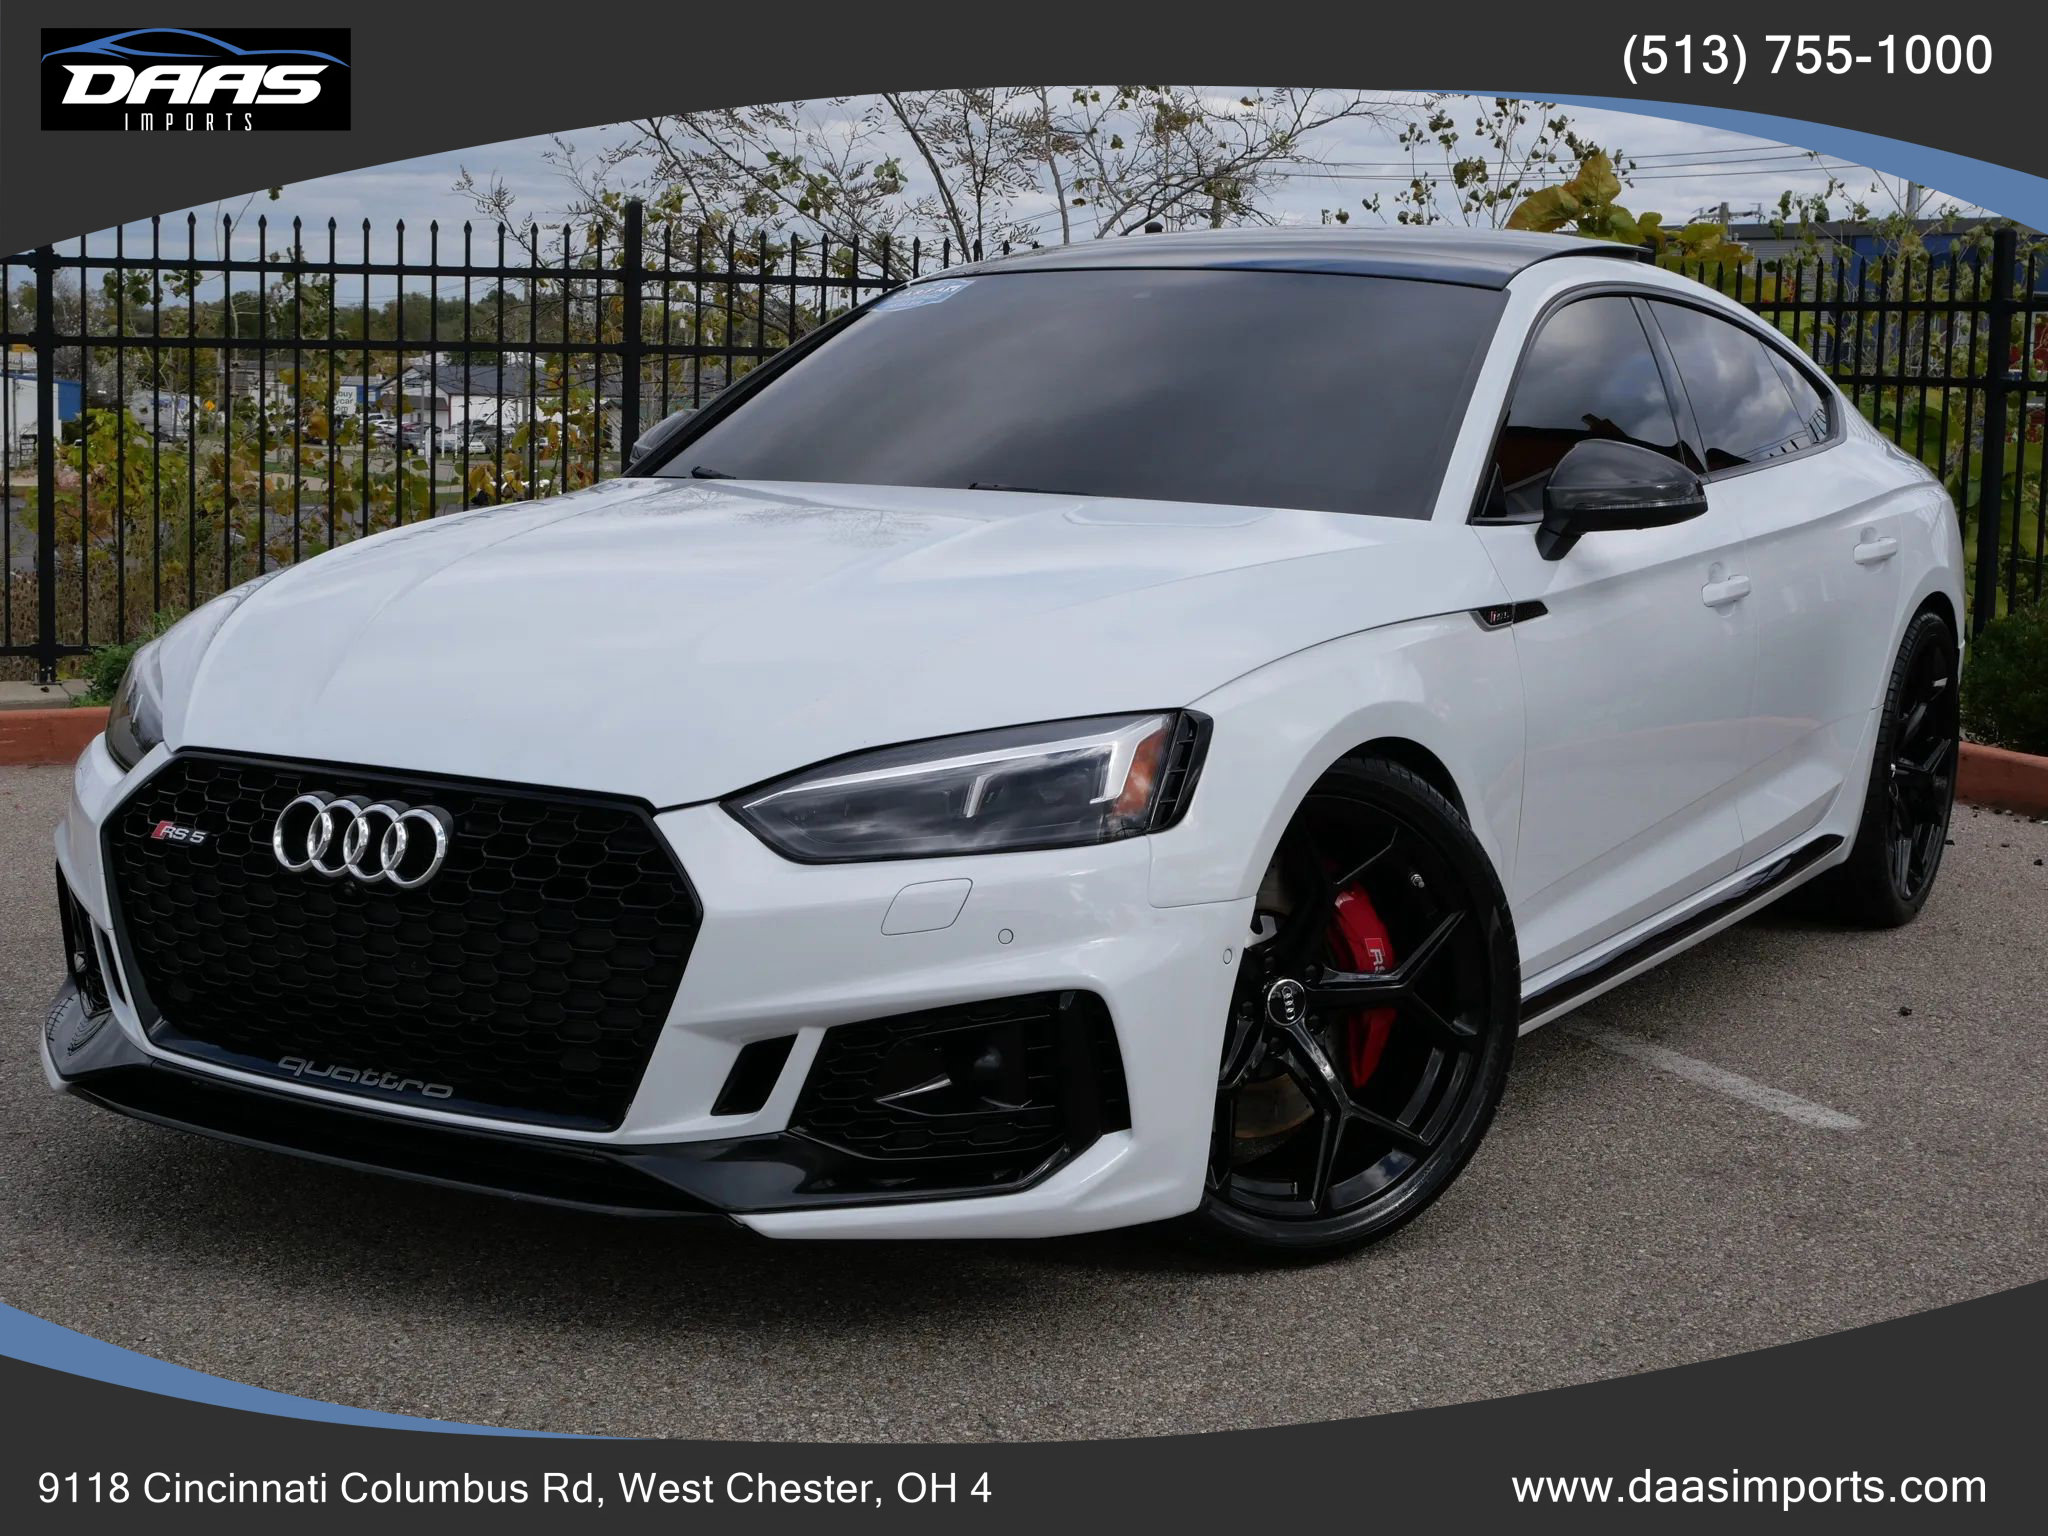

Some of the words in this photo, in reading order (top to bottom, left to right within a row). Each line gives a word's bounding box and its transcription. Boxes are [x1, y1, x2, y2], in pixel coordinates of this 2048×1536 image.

[160, 825, 190, 840] RS
[190, 830, 207, 844] 5
[277, 1055, 454, 1099] quattro
